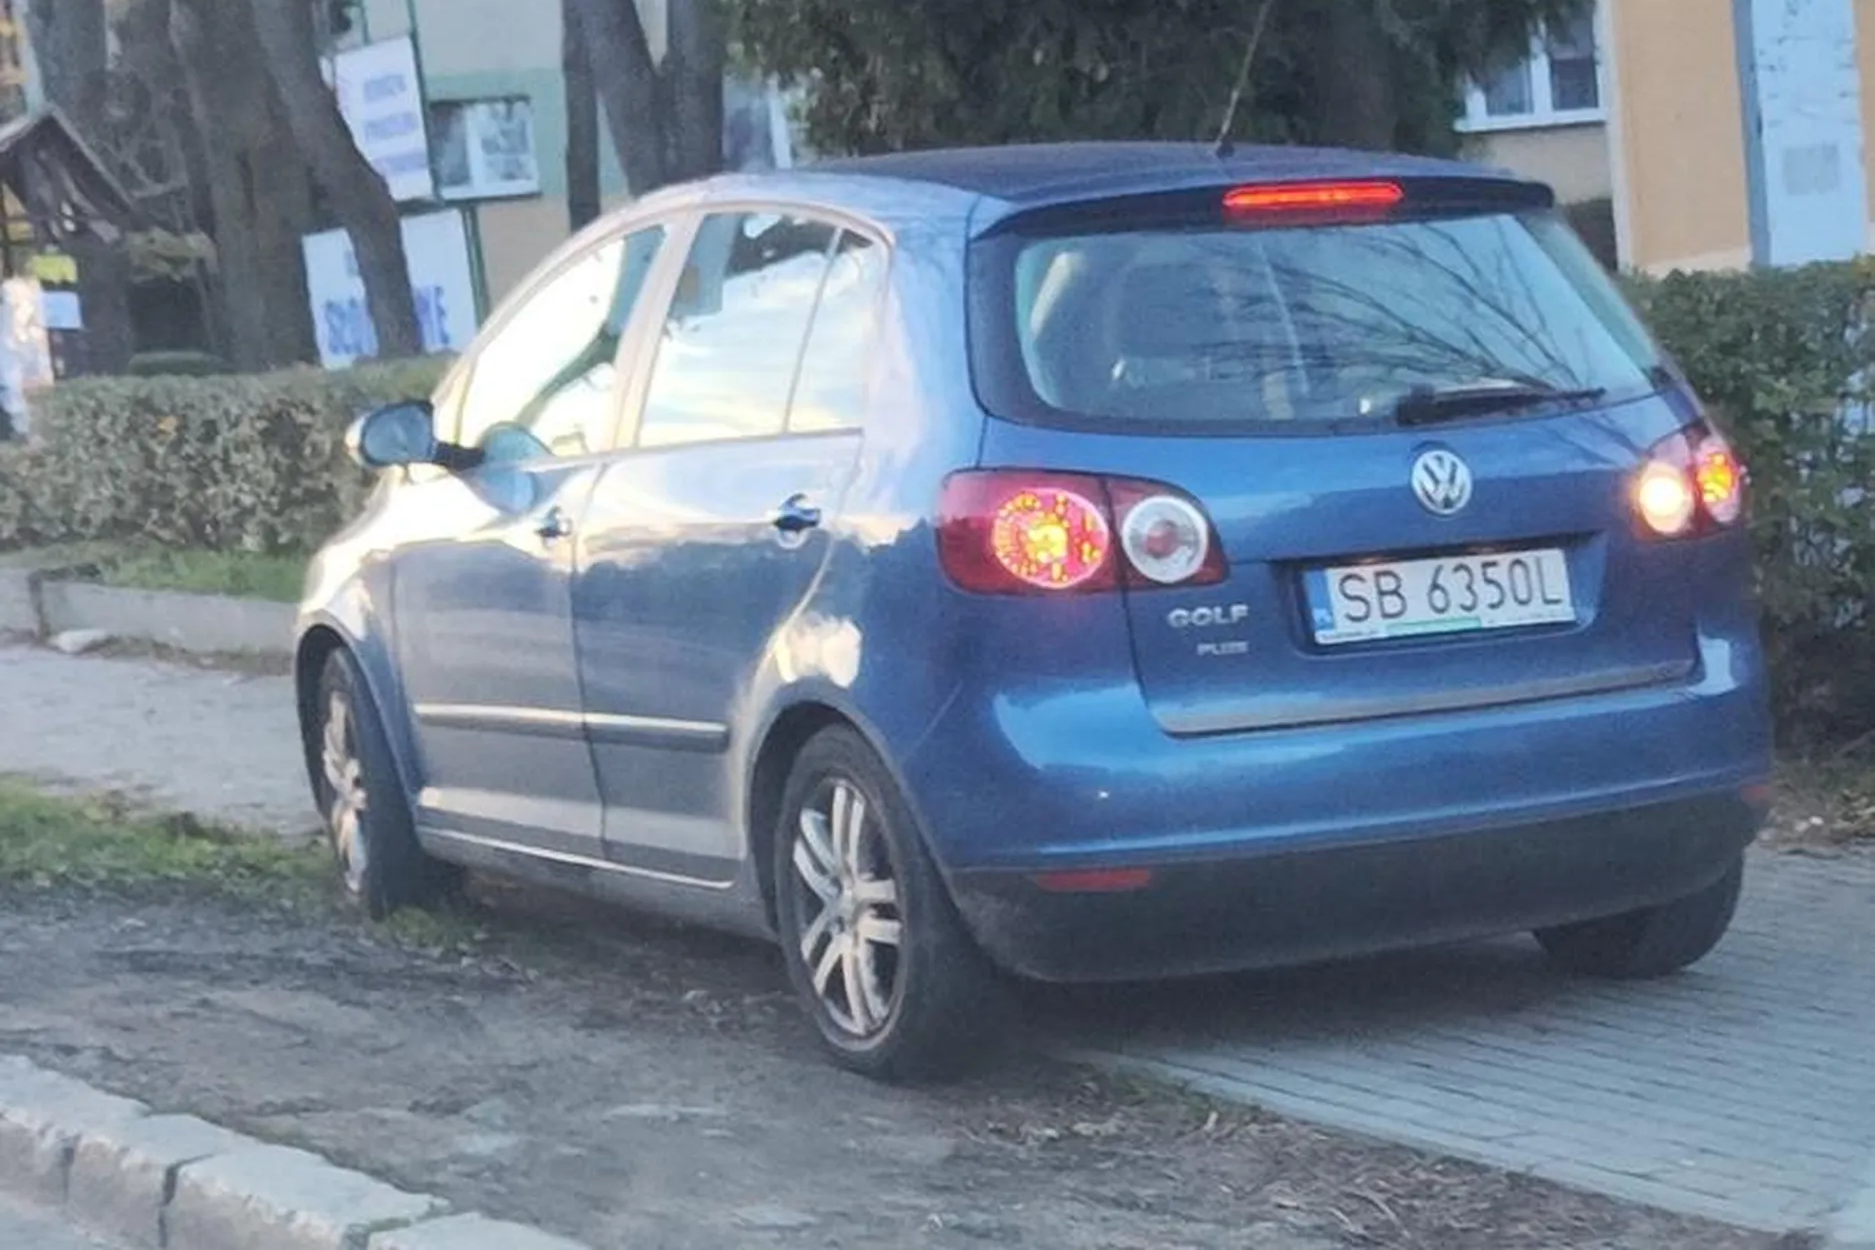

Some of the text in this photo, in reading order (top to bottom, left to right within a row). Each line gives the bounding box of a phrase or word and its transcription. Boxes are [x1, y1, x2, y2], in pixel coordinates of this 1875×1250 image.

[1338, 556, 1564, 623] SB 6350L
[1167, 603, 1250, 628] GOLF
